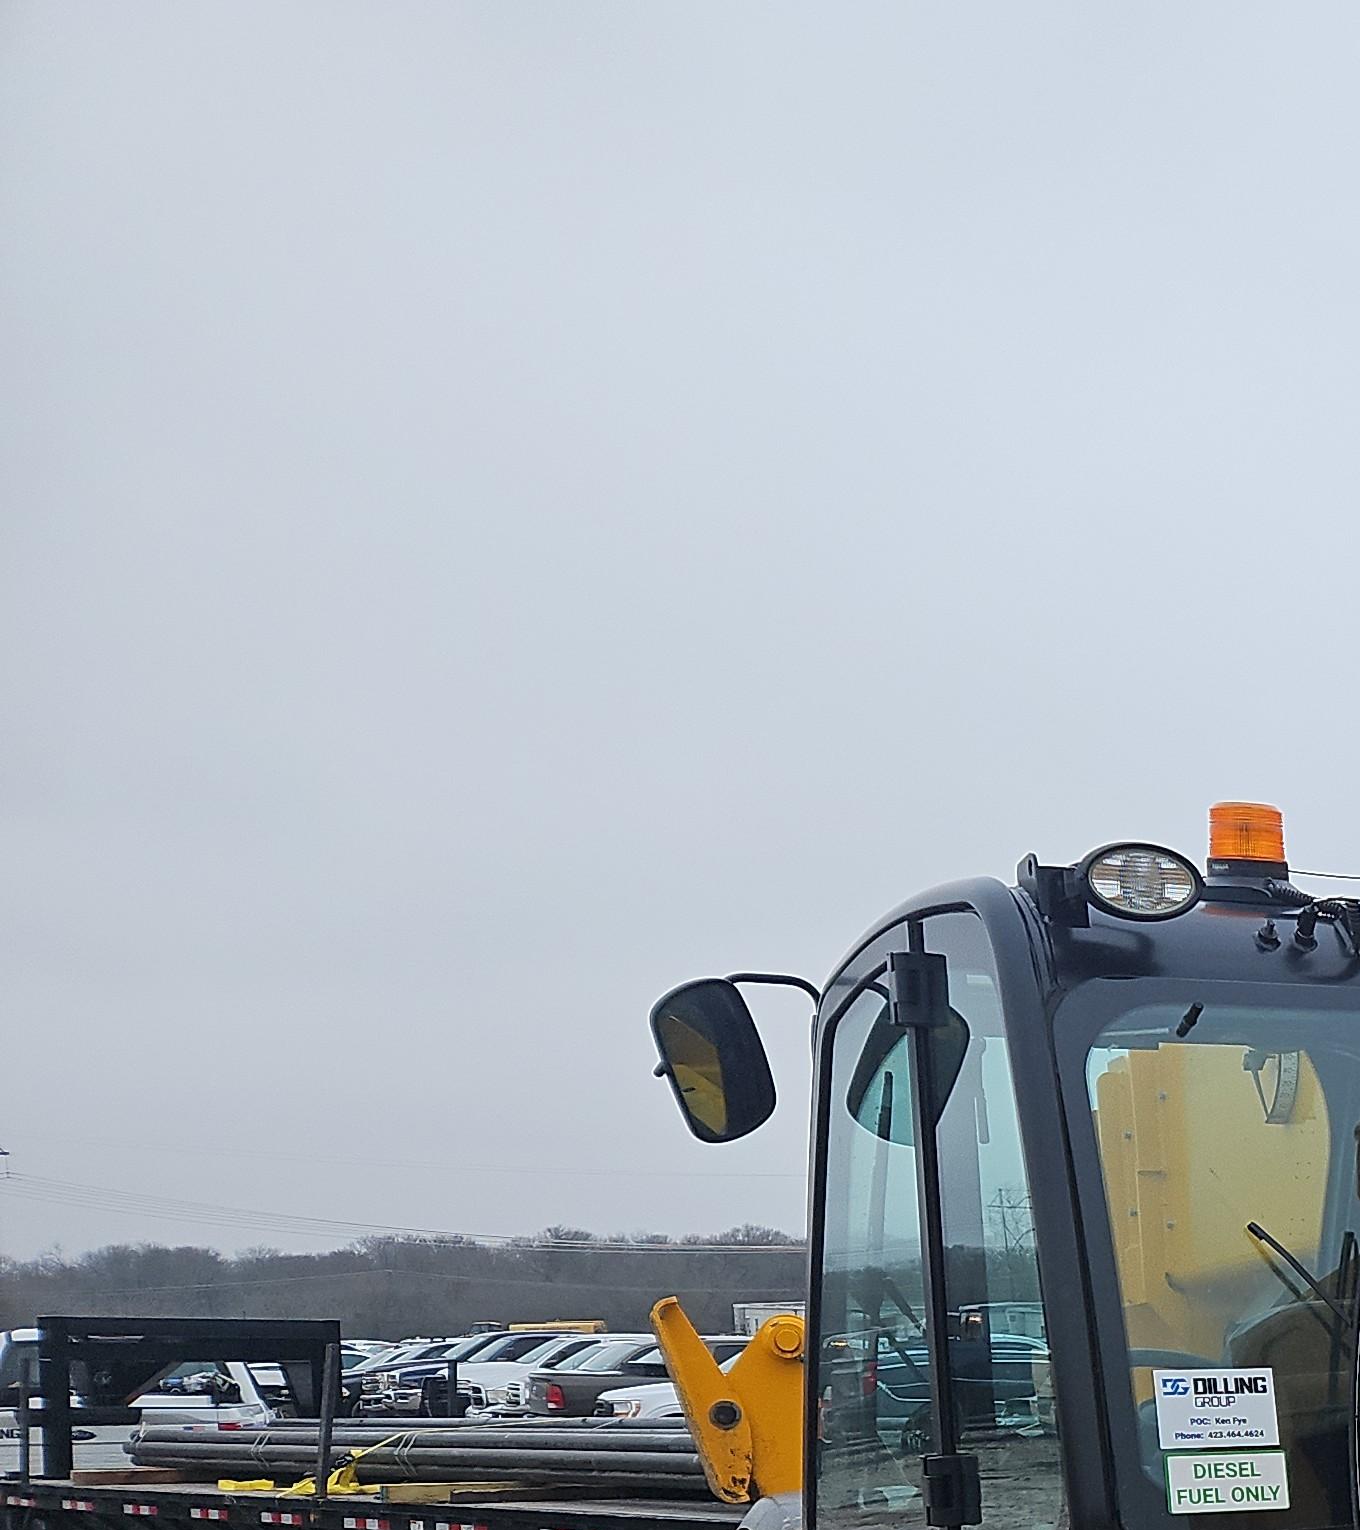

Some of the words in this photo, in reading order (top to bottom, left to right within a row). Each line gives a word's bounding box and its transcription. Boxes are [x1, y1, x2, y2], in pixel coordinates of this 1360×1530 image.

[1193, 1377, 1268, 1395] DILLING
[1194, 1396, 1236, 1408] GROUP
[1190, 1417, 1211, 1426] POC:
[1214, 1417, 1231, 1425] Ken
[1174, 1431, 1204, 1440] Phone:
[1207, 1430, 1265, 1439] 423.464.4624
[1193, 1461, 1262, 1479] DIESEL
[1176, 1487, 1226, 1505] FUEL
[1231, 1485, 1281, 1503] ONLY
